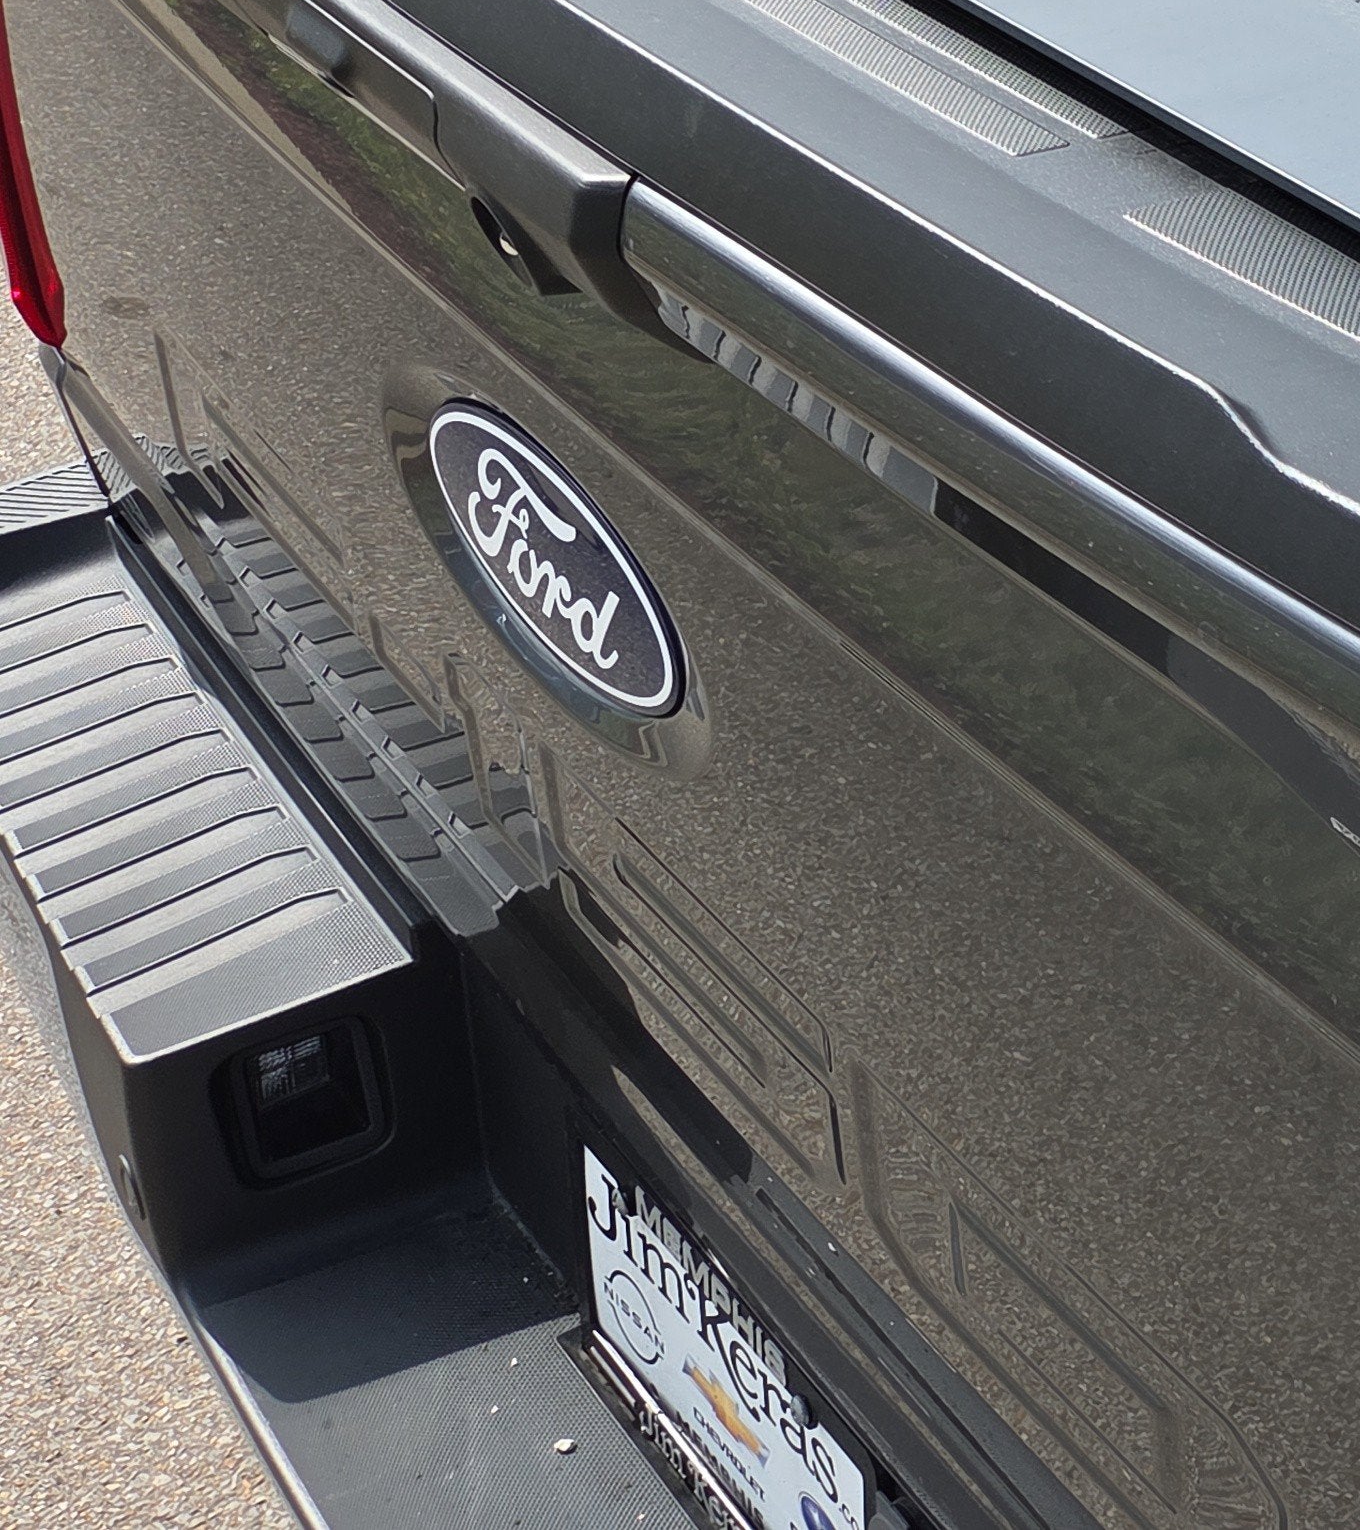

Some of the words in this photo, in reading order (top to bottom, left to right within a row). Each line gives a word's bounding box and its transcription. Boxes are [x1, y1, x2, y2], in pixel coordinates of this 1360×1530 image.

[468, 448, 619, 669] Ford
[604, 1281, 665, 1354] NISSAN
[635, 1185, 787, 1387] MEMPHIS
[640, 1409, 686, 1479] Jim
[692, 1406, 765, 1502] CHEVROLET
